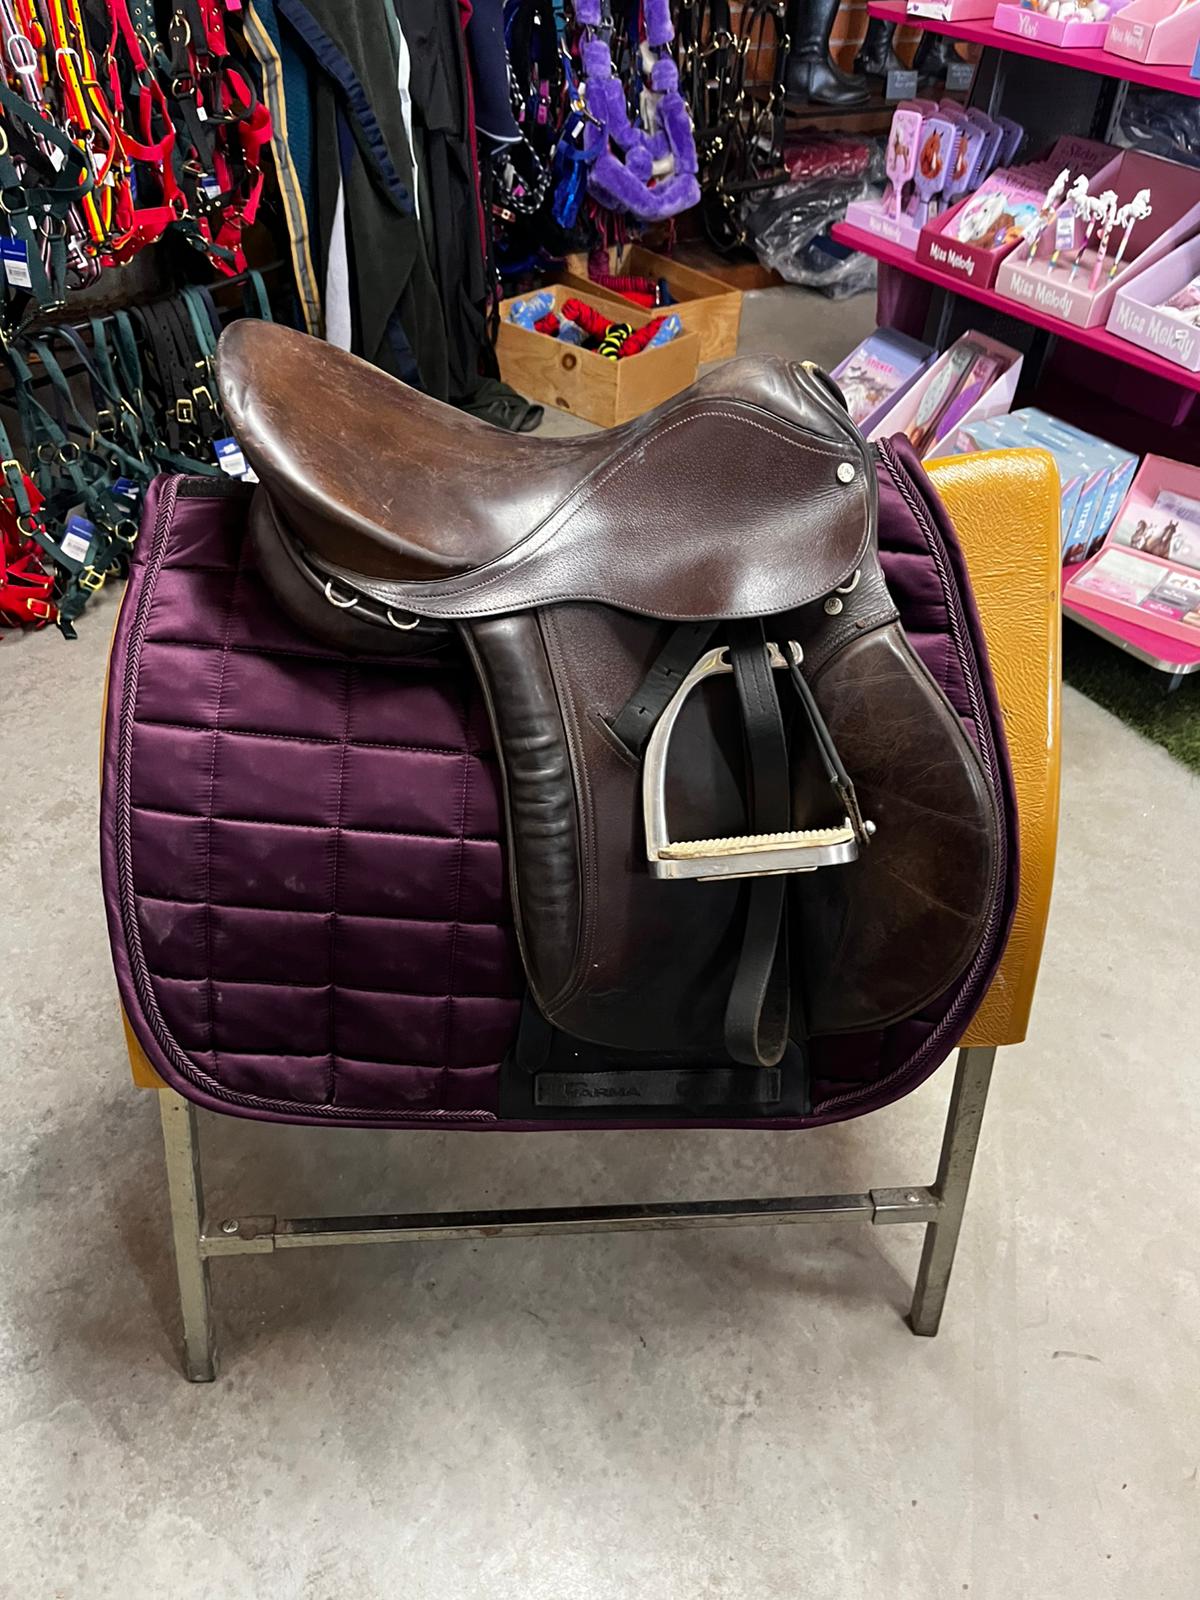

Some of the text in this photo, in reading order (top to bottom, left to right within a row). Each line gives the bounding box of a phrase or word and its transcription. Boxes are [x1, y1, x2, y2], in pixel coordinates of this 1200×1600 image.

[929, 242, 975, 277] Miss Melody
[1009, 272, 1073, 318] Miss Melody
[1116, 301, 1144, 335] Miss
